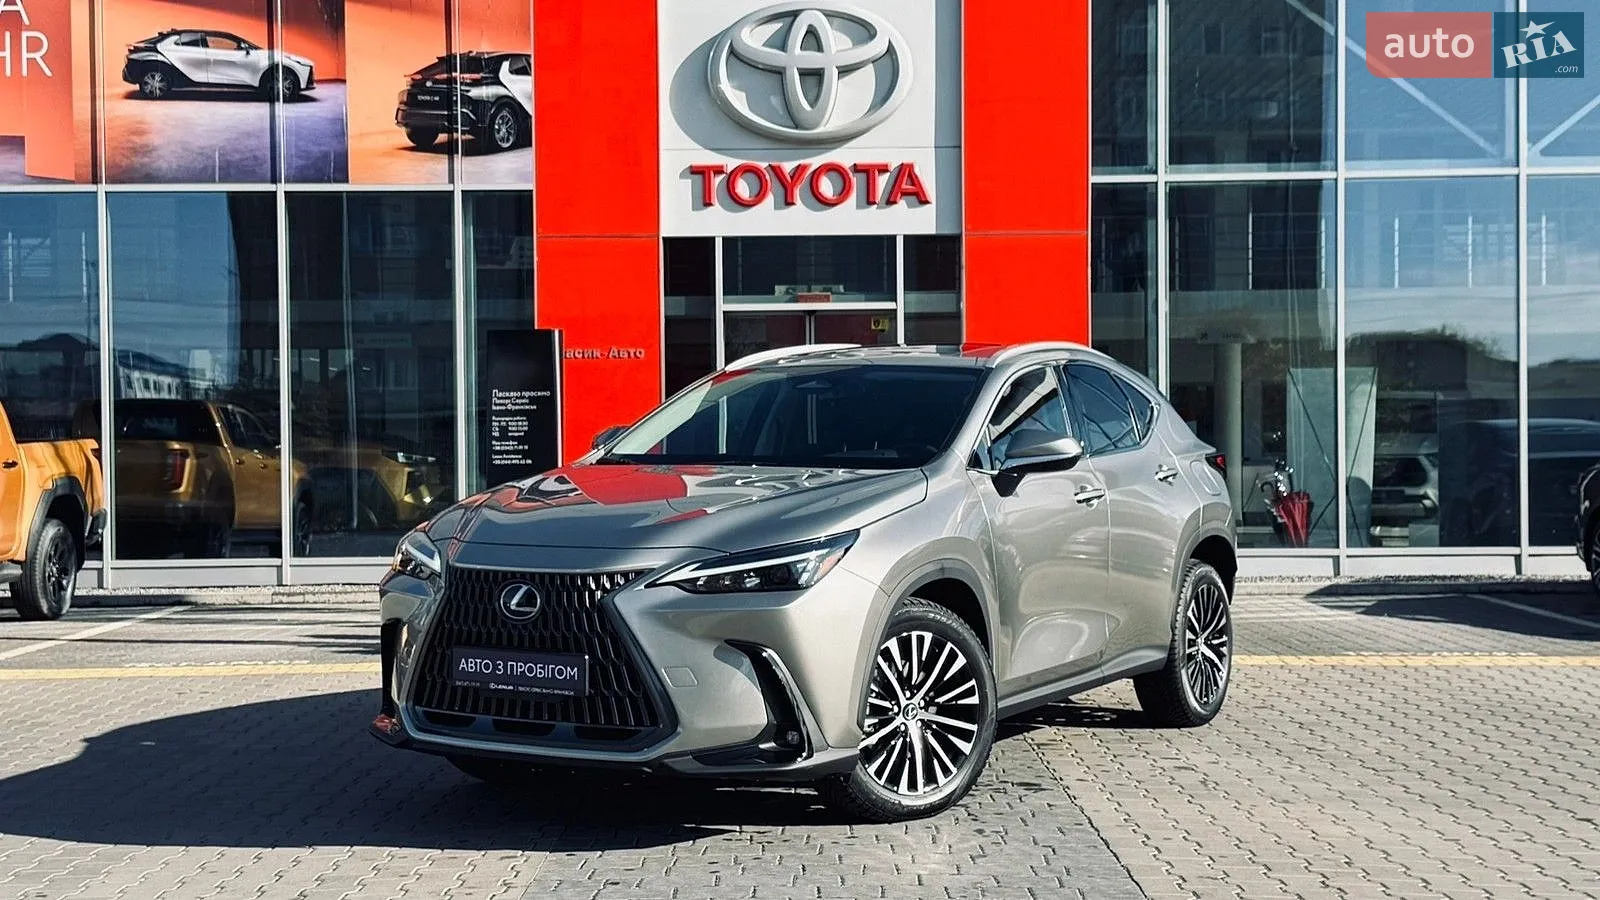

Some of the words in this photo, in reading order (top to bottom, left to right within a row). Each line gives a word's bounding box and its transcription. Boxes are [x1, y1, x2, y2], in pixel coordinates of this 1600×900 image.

[690, 162, 933, 208] TOYOTA
[458, 657, 493, 674] АВТО
[507, 661, 578, 681] ПРОБІГОМ
